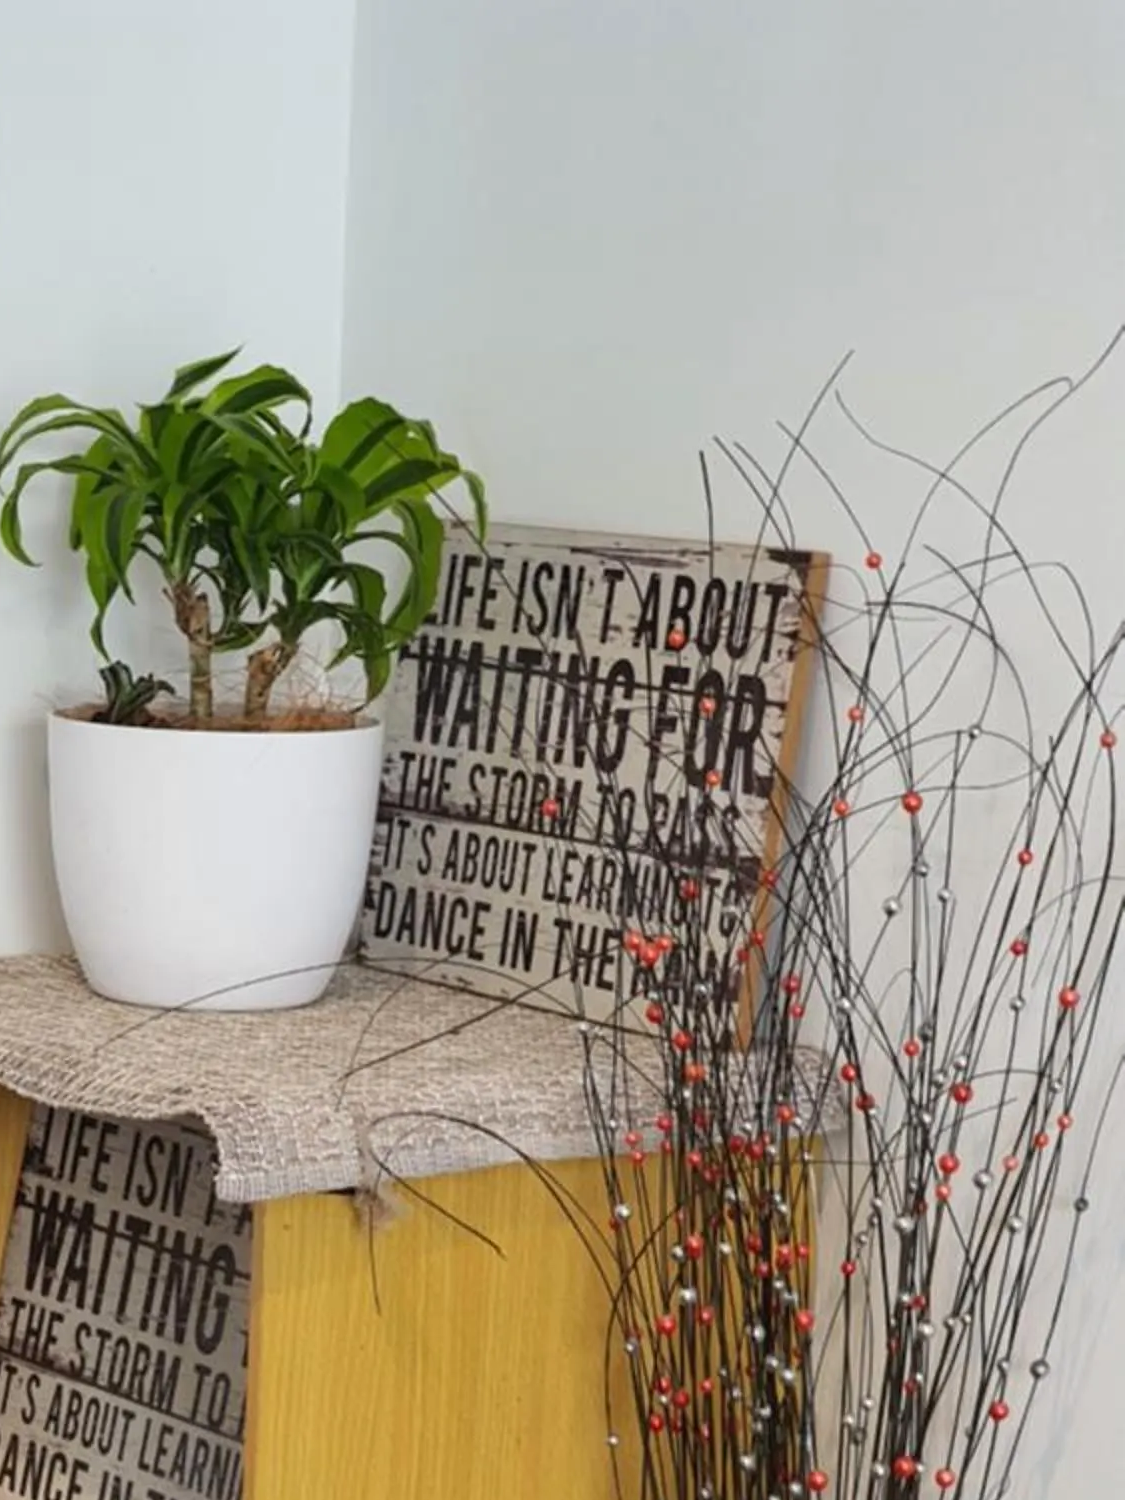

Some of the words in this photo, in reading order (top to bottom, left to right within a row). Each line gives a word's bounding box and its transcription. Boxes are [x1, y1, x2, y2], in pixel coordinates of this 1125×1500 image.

[423, 554, 504, 630] IFE
[512, 560, 624, 645] ISN'T
[632, 572, 789, 663] ABOUT
[414, 634, 635, 774] WAITING
[643, 664, 769, 795] FOR
[400, 751, 456, 816] THE
[465, 763, 582, 838] STORM
[597, 783, 636, 849] TO
[383, 817, 436, 876] IT'S
[442, 828, 537, 896] ABOUT
[374, 880, 491, 962] DANCE
[499, 908, 539, 973] IN
[554, 917, 623, 991] THE
[37, 1107, 119, 1194] LIFE
[26, 1185, 236, 1355] WAITING
[8, 1297, 64, 1367] THE
[69, 1321, 181, 1416] STORM
[191, 1363, 231, 1430] TO
[43, 1384, 136, 1462] ABOUT
